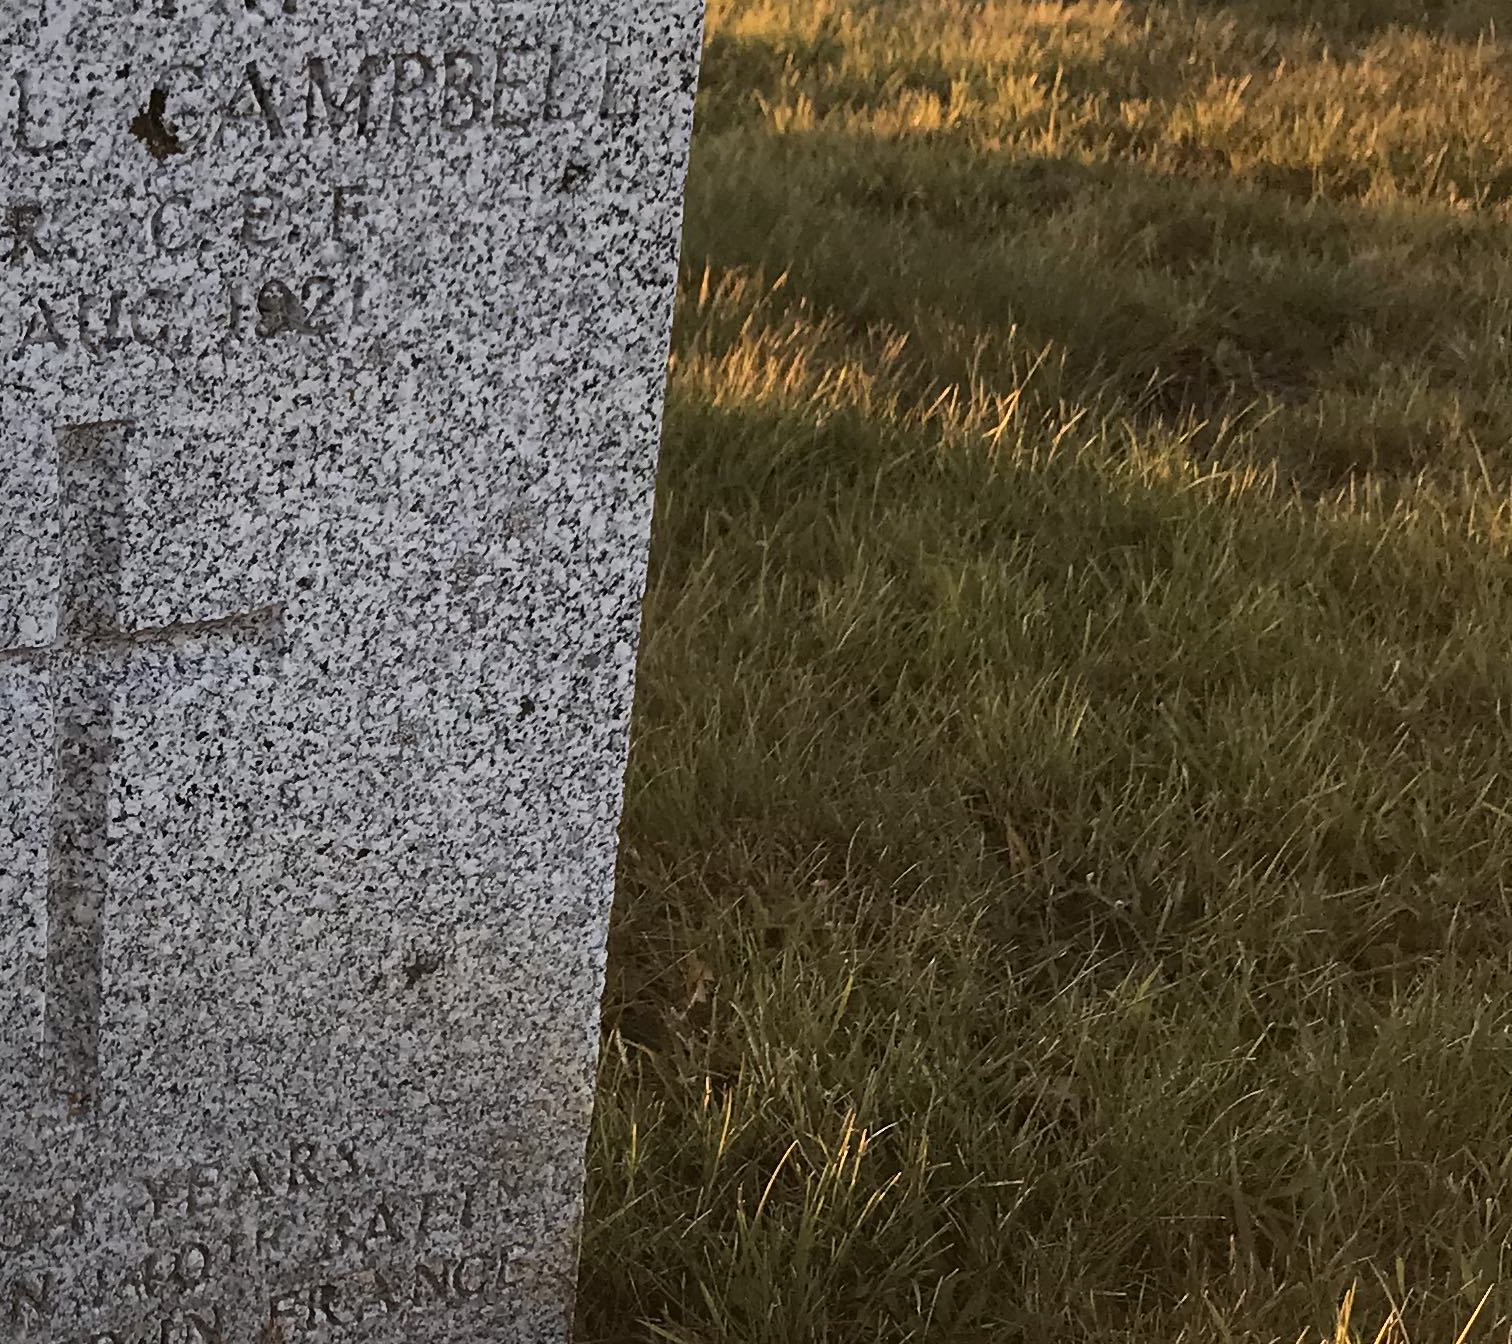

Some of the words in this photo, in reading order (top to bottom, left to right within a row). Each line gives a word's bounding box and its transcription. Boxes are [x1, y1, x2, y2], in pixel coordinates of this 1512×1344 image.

[144, 38, 642, 157] CAMPBELL
[138, 1139, 360, 1219] YEARS
[268, 1249, 526, 1338] FRANCE
